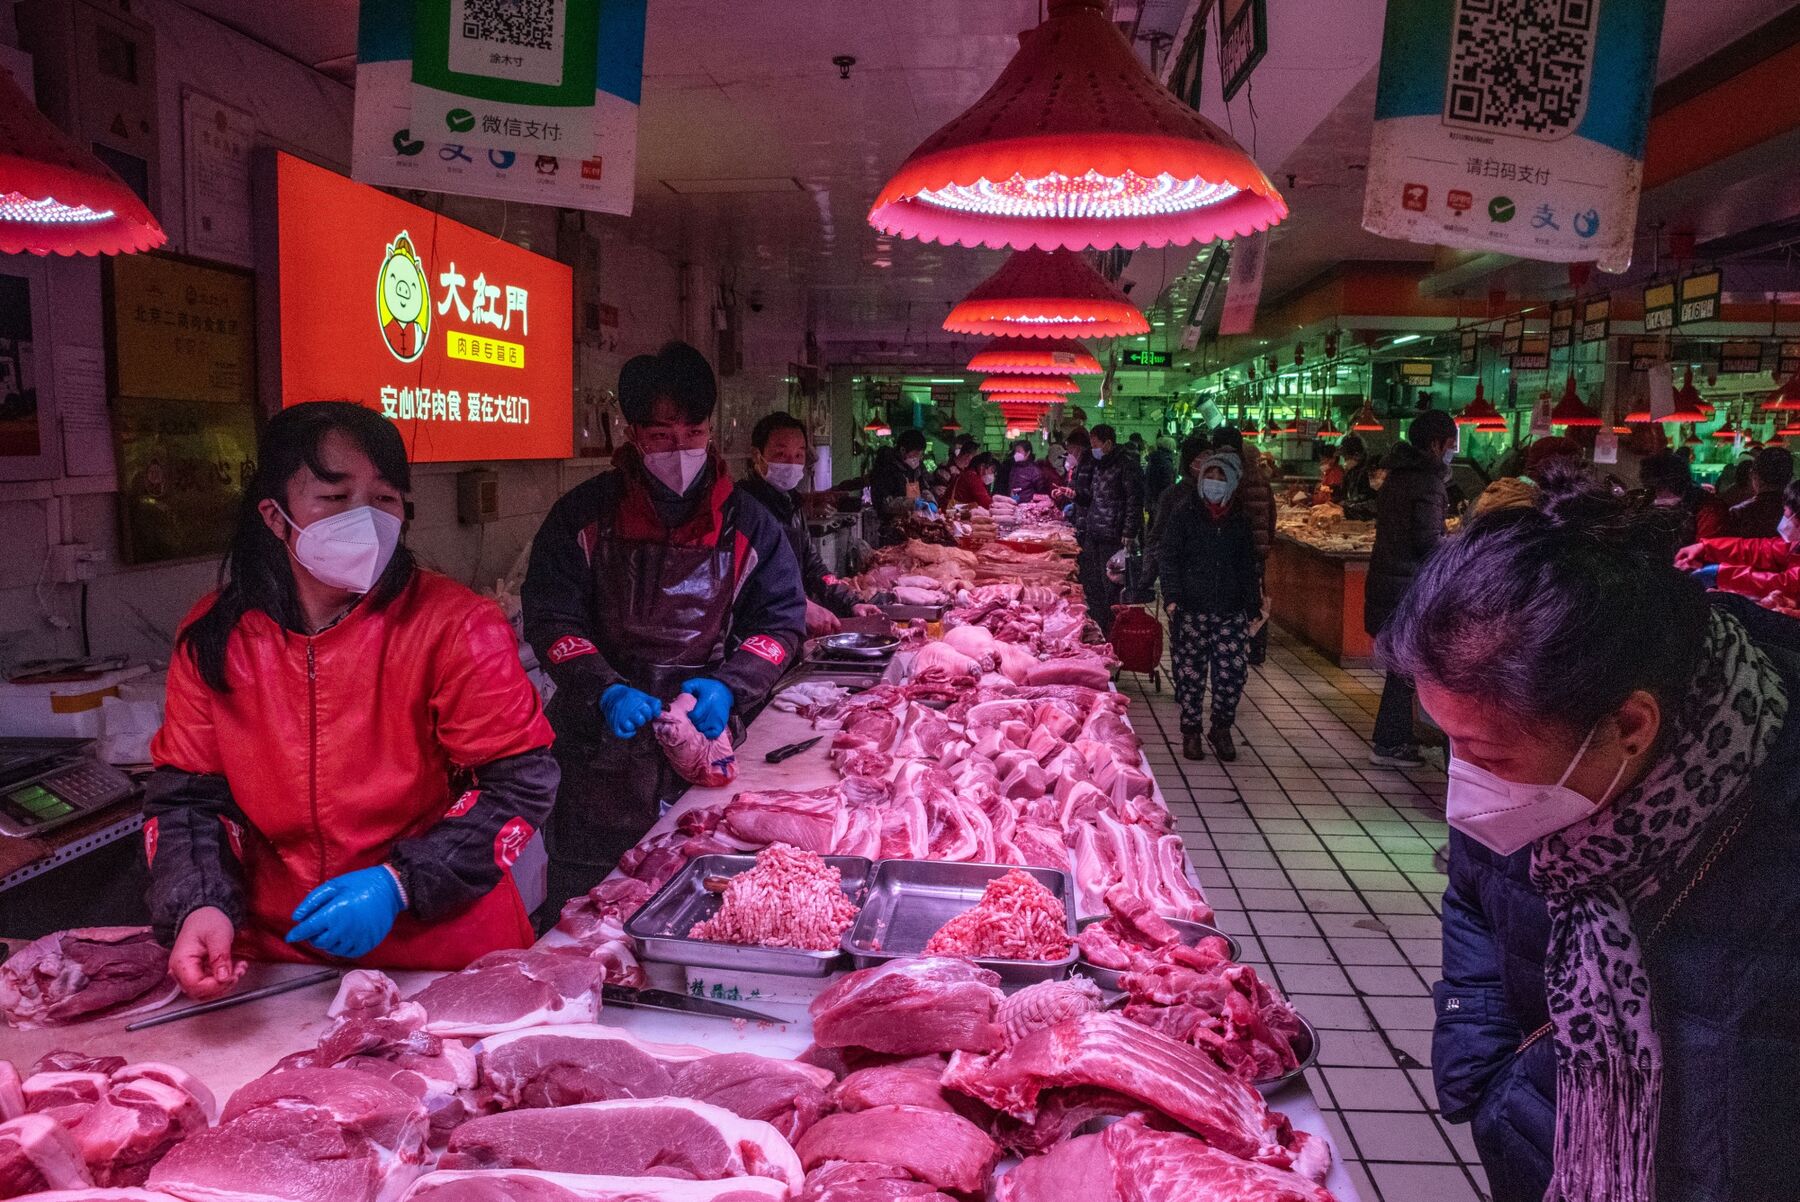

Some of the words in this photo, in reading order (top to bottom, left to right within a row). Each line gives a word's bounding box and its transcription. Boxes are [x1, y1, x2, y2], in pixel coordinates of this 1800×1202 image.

[482, 114, 560, 141] 微信支付
[1466, 157, 1551, 186] 请扫码支付
[457, 338, 517, 363] 肉食专营店
[380, 385, 461, 421] 安心好肉食
[467, 392, 530, 424] 爱在大红门
